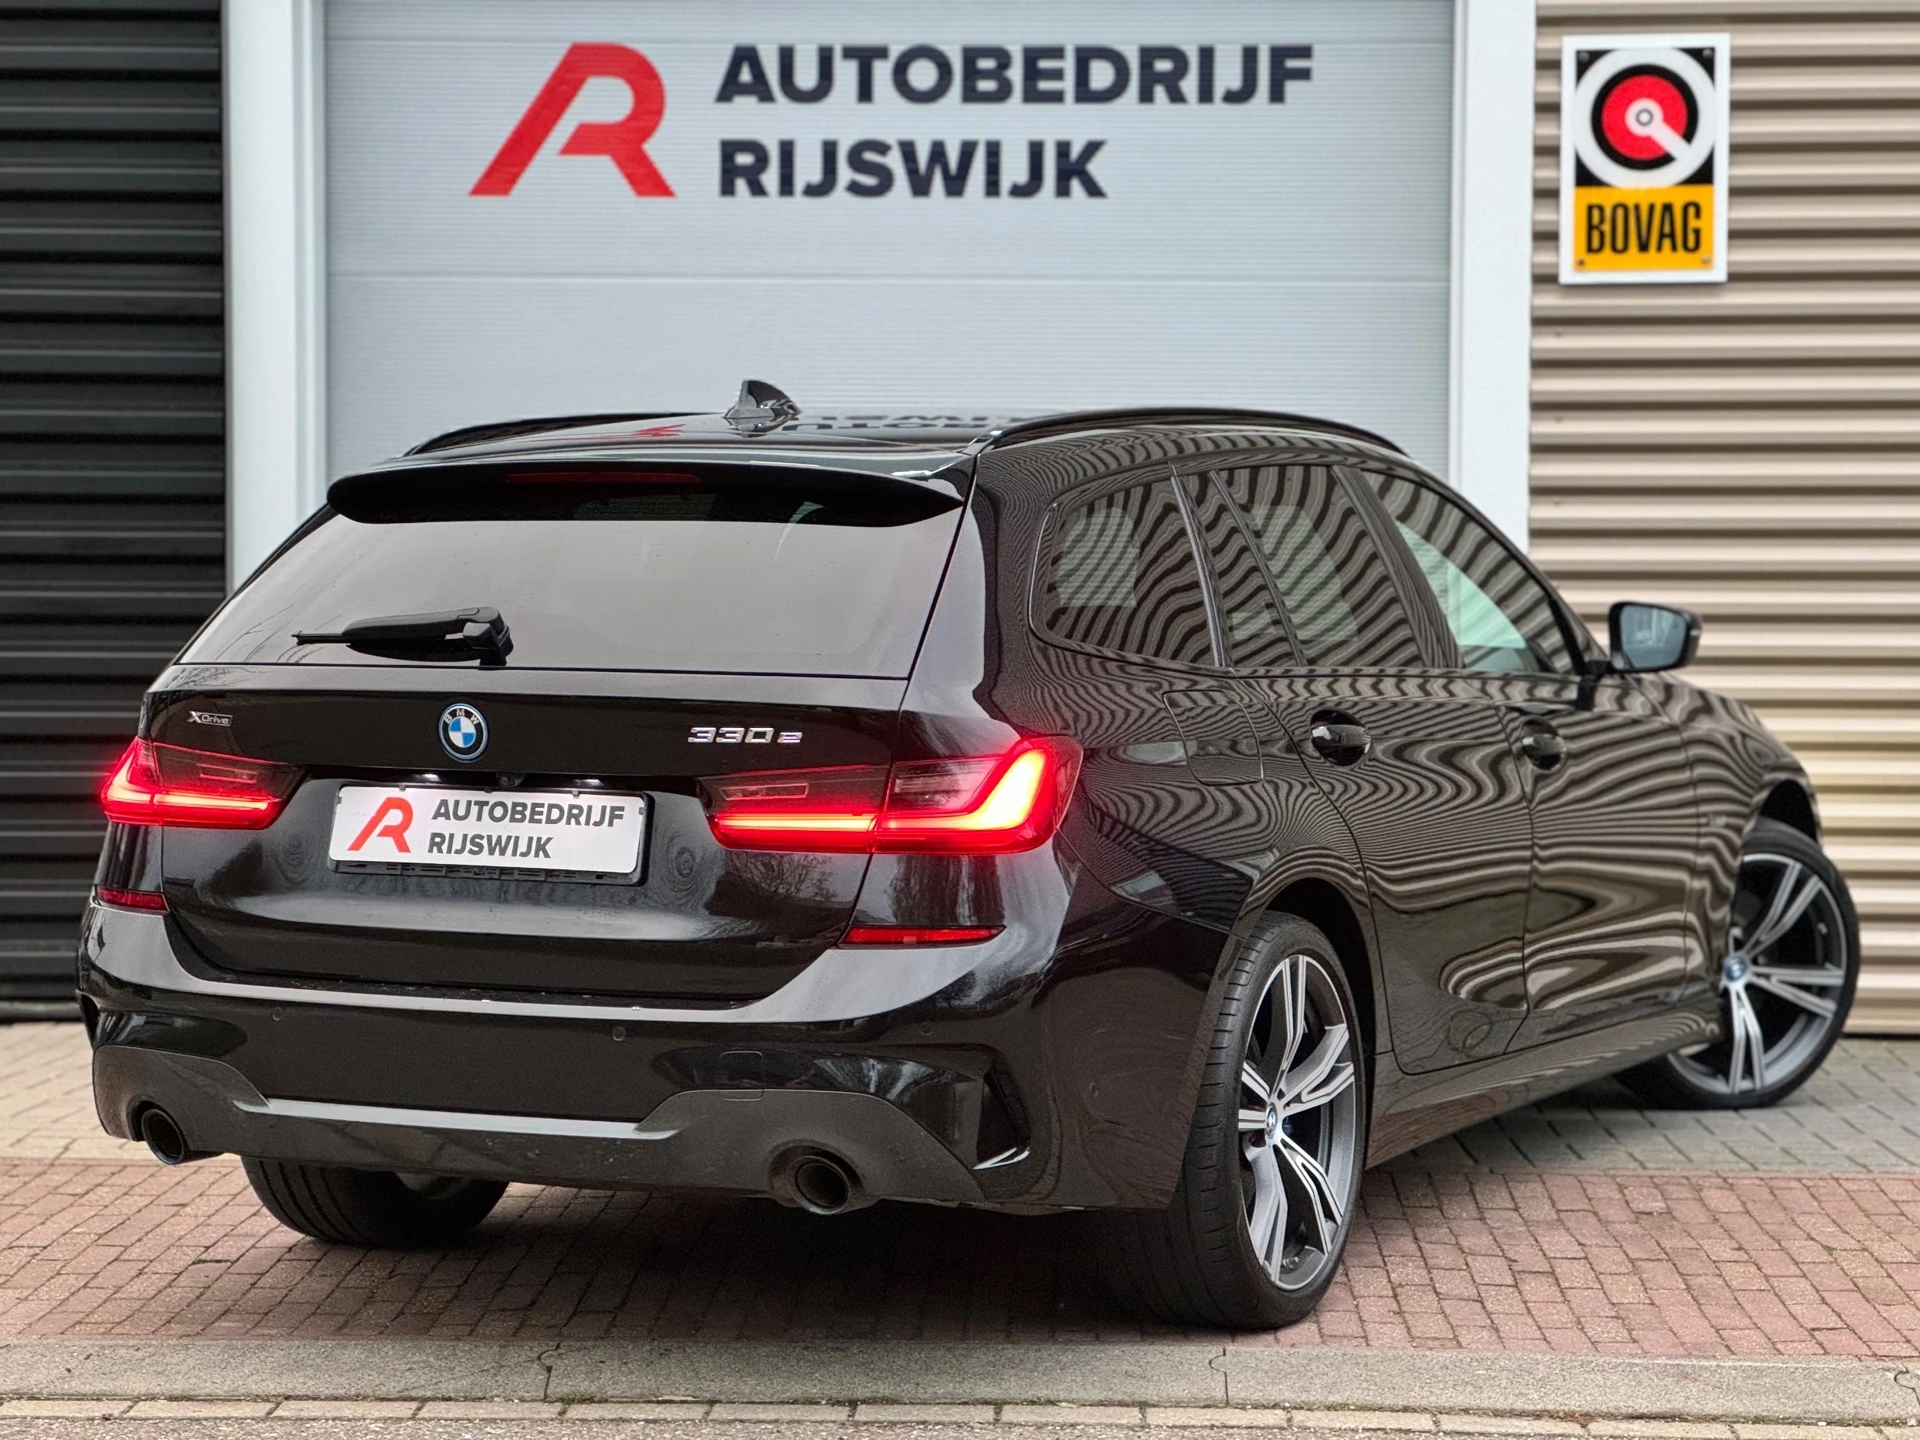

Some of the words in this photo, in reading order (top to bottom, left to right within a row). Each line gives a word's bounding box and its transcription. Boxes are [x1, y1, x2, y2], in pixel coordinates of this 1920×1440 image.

[715, 44, 1313, 104] AUTOBEDRIJF
[719, 139, 1107, 197] RIJSWIJK
[1586, 201, 1702, 254] BOVAG
[444, 709, 480, 725] BMW
[431, 799, 625, 827] AUTOBEDRIJF
[427, 832, 553, 858] RIJSWIJK
